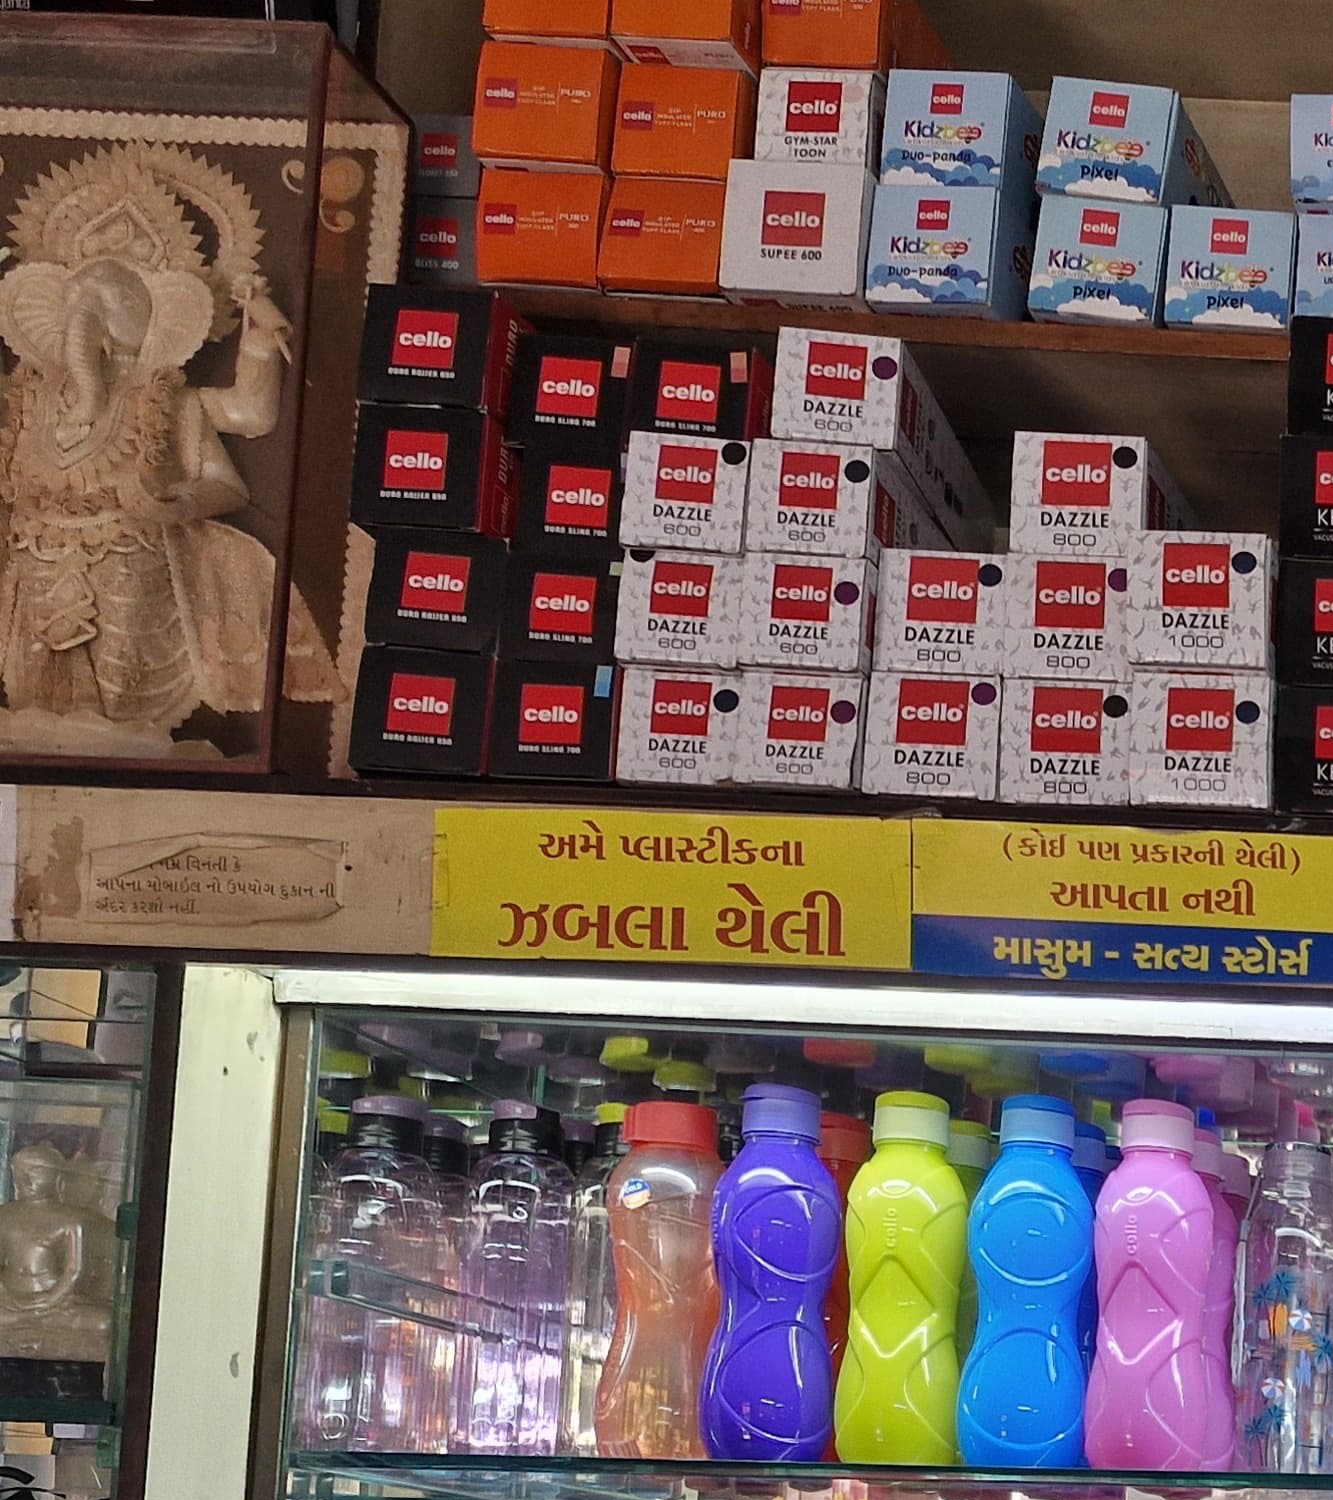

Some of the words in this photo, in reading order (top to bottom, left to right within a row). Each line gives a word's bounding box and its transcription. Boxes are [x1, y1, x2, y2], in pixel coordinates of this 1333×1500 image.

[697, 109, 726, 119] PURO
[789, 99, 836, 116] cello
[784, 135, 839, 149] GYM-STAR
[793, 147, 826, 159] TOON
[766, 211, 821, 228] cello
[1083, 223, 1116, 236] cello
[760, 248, 797, 261] SUPEE
[800, 249, 823, 262] 600
[809, 362, 862, 381] cello
[803, 399, 864, 419] DAZZLE
[814, 419, 853, 432] 600
[1045, 464, 1107, 483] cello
[1040, 511, 1110, 529] DAZZLE
[1052, 532, 1097, 547] 800
[1165, 566, 1225, 585] cello
[1161, 612, 1230, 630] DAZZLE
[1168, 634, 1224, 649] 1000
[537, 819, 607, 861] અમે
[618, 825, 806, 867] પ્લાસ્ટીકના
[1076, 838, 1121, 863] પણ
[1129, 838, 1226, 867] પ્રકારની
[1234, 837, 1302, 876] થેલી)
[1048, 879, 1168, 913] આપતા
[1181, 878, 1257, 917] નથી
[497, 902, 690, 952] ઝબલા
[714, 882, 847, 957] થેલી
[992, 933, 1093, 980] માસુમ
[1132, 941, 1210, 973] સત્ય
[1220, 934, 1314, 977] સ્ટોર્સ
